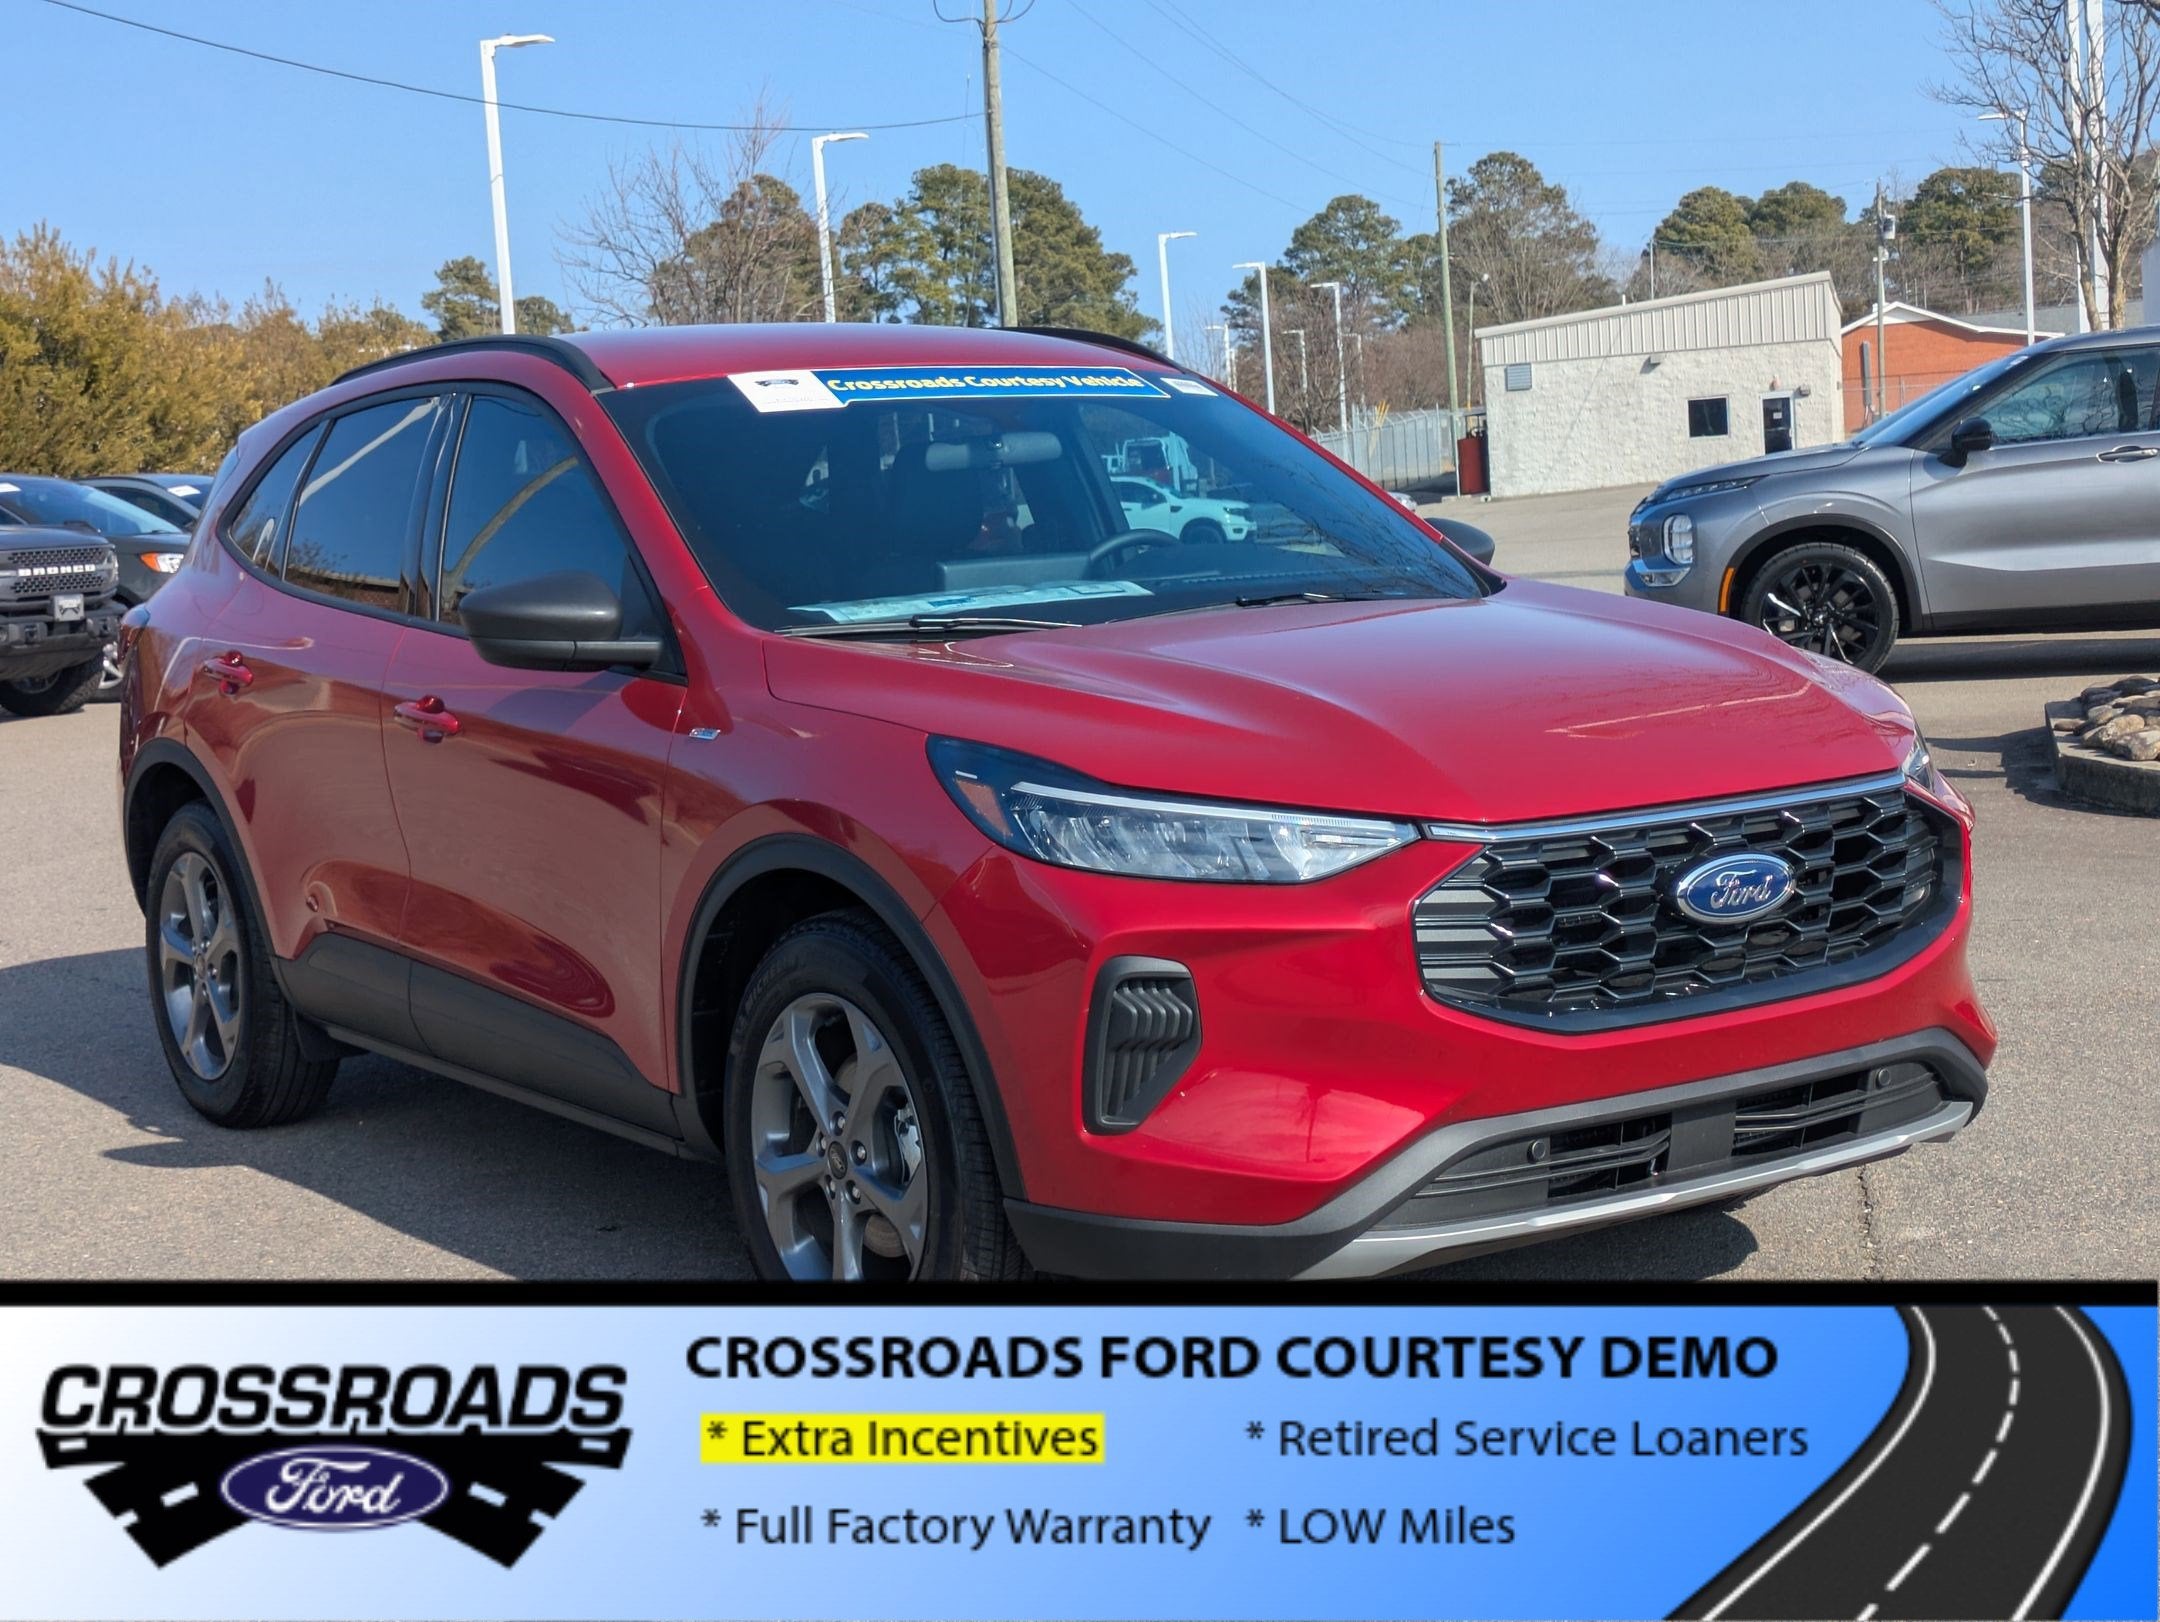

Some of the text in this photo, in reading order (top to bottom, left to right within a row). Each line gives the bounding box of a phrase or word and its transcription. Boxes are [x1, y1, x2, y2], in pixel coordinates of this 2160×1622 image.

[827, 375, 1145, 391] Crossroads Courtesy Vehicle
[1710, 869, 1773, 909] Ford
